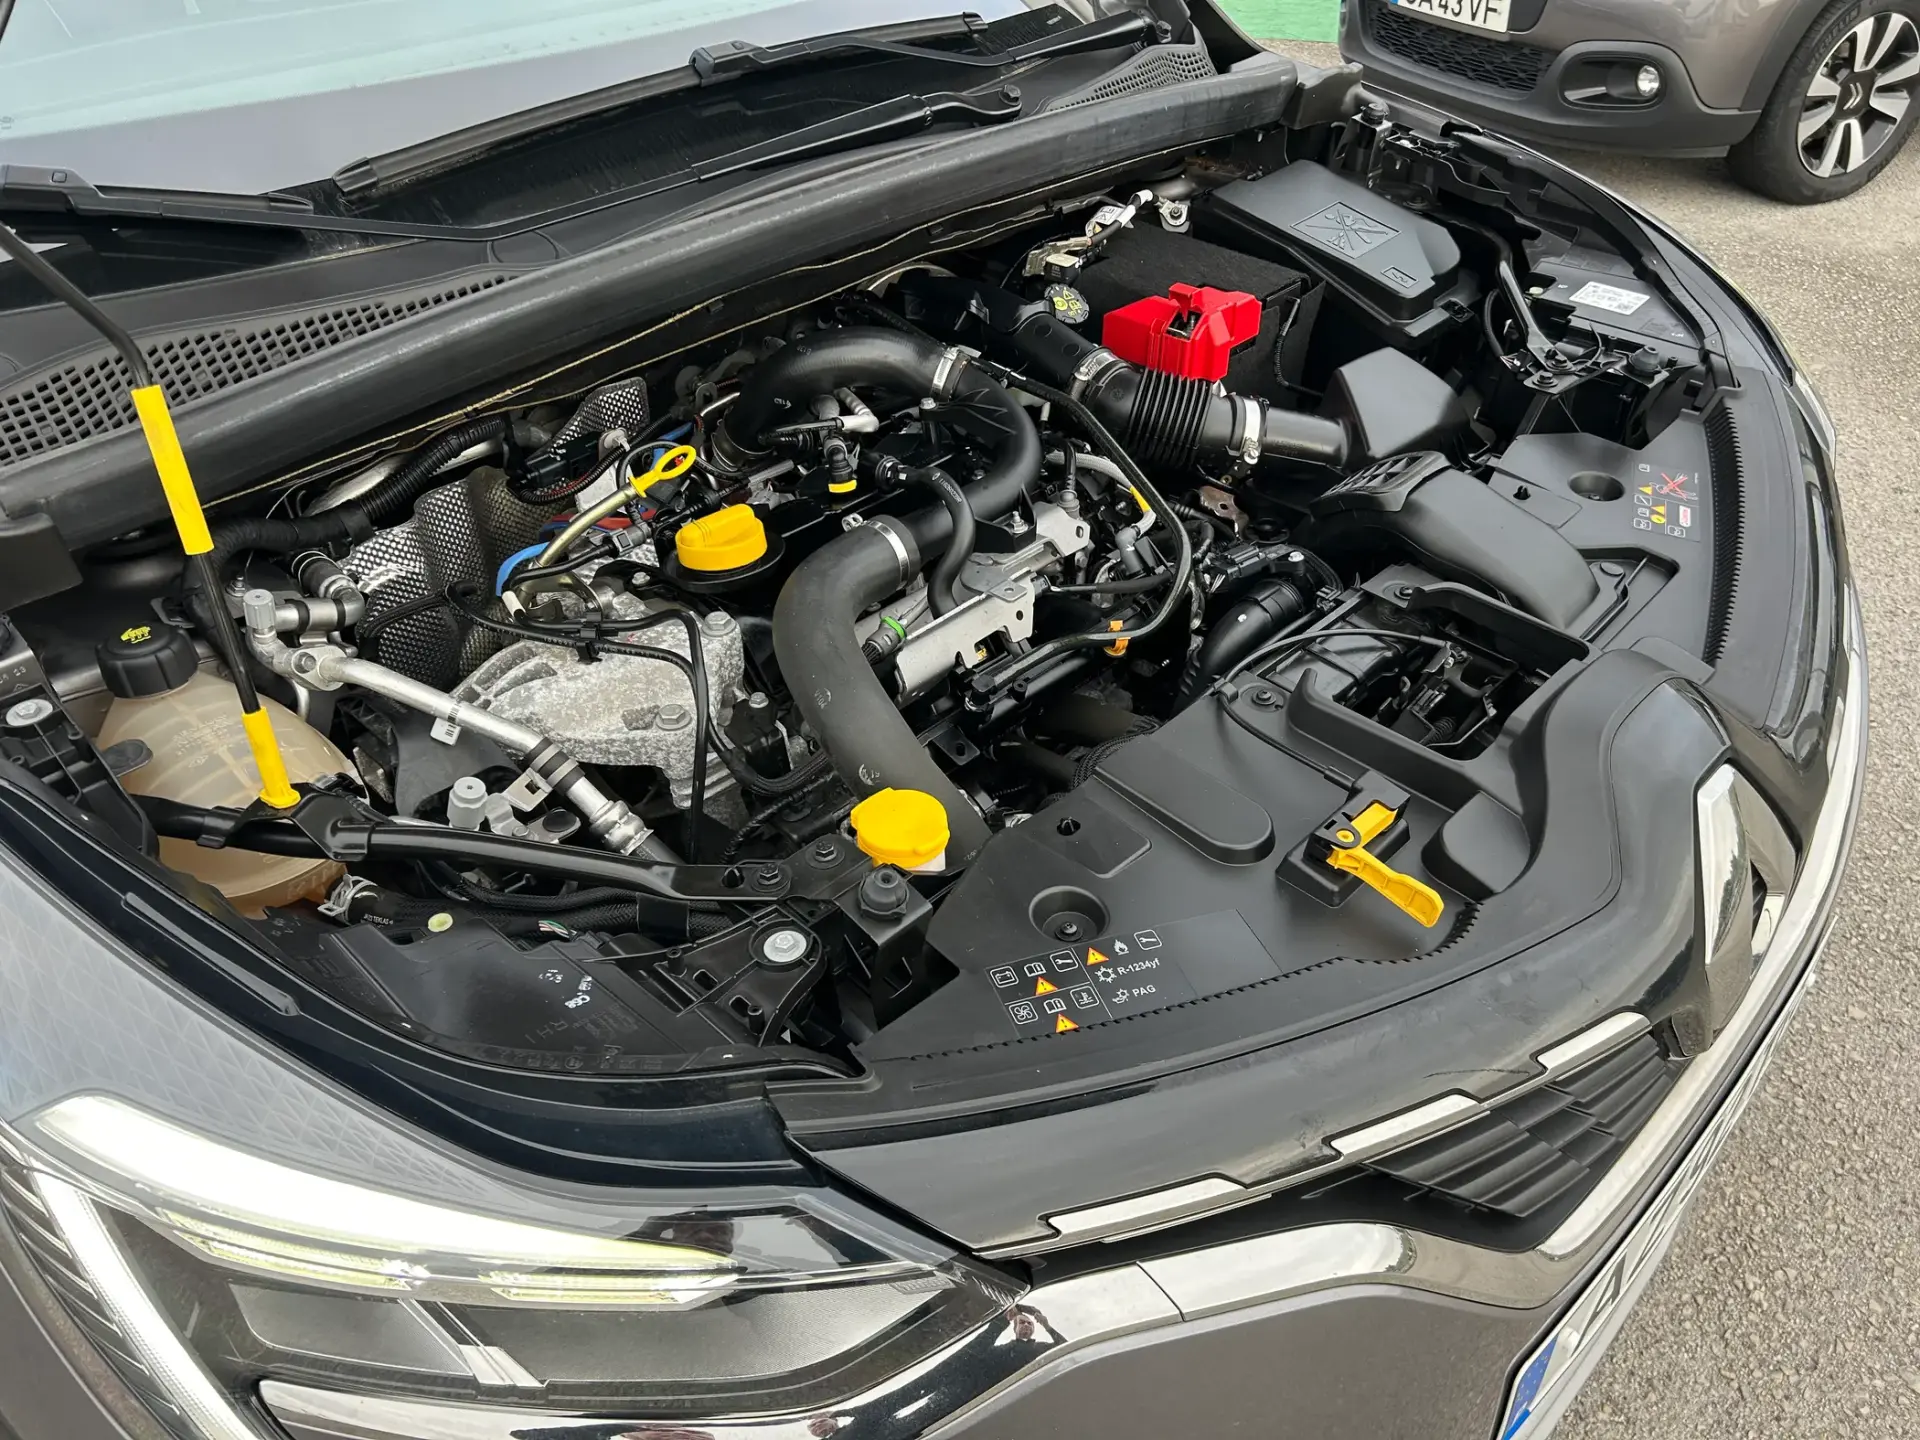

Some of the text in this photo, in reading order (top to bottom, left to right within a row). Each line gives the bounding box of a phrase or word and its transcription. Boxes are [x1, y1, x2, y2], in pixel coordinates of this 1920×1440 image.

[1407, 0, 1503, 24] 43VF
[1117, 957, 1160, 976] R-1234yf
[1132, 984, 1157, 998] PAG
